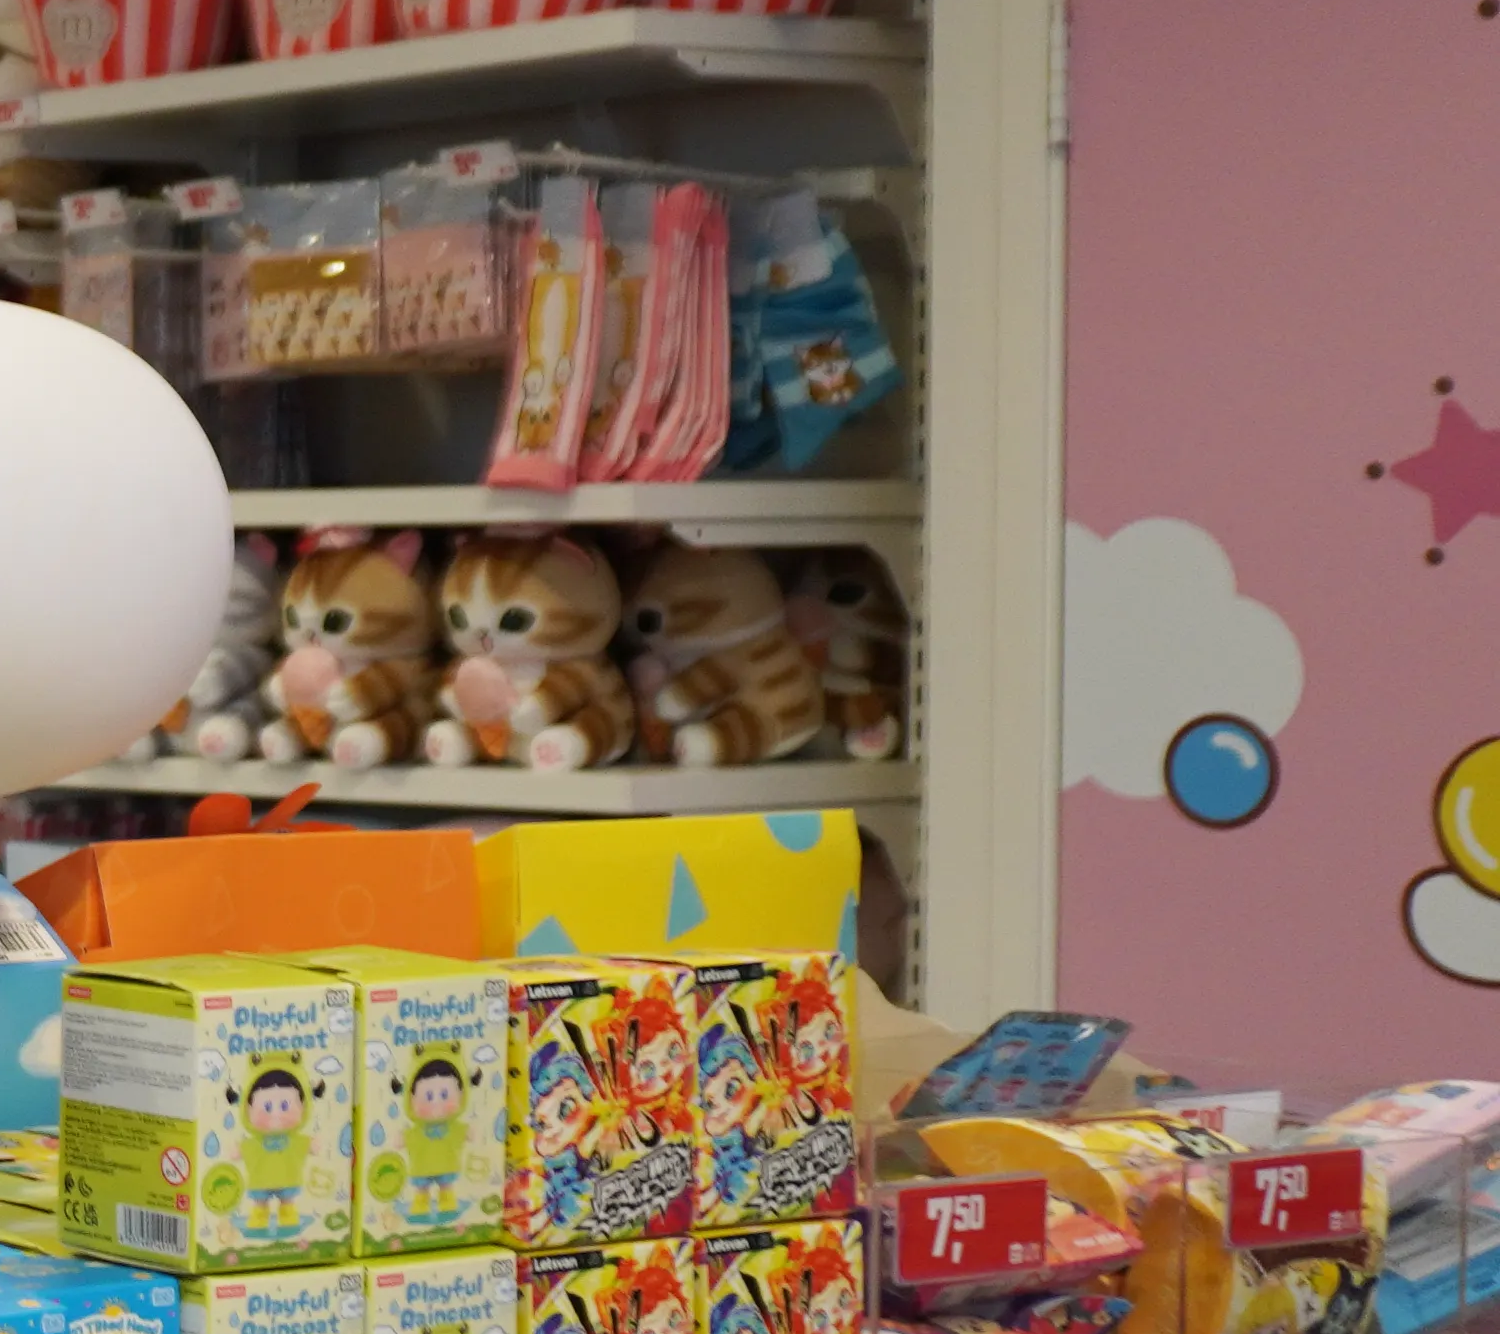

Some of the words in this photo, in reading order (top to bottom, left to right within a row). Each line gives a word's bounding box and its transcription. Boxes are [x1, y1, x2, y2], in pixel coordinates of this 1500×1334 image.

[698, 968, 741, 982] Letsvan
[528, 985, 573, 999] Letsvan
[234, 1001, 317, 1033] Playful
[398, 995, 476, 1024] Playful
[228, 1031, 329, 1056] Raincoat
[393, 1022, 486, 1047] Raincoat
[1255, 1165, 1309, 1231] 7,50
[926, 1194, 985, 1264] 7,50
[247, 1291, 331, 1321] Playful
[406, 1277, 485, 1306] Playful
[400, 1301, 494, 1330] Raincoat
